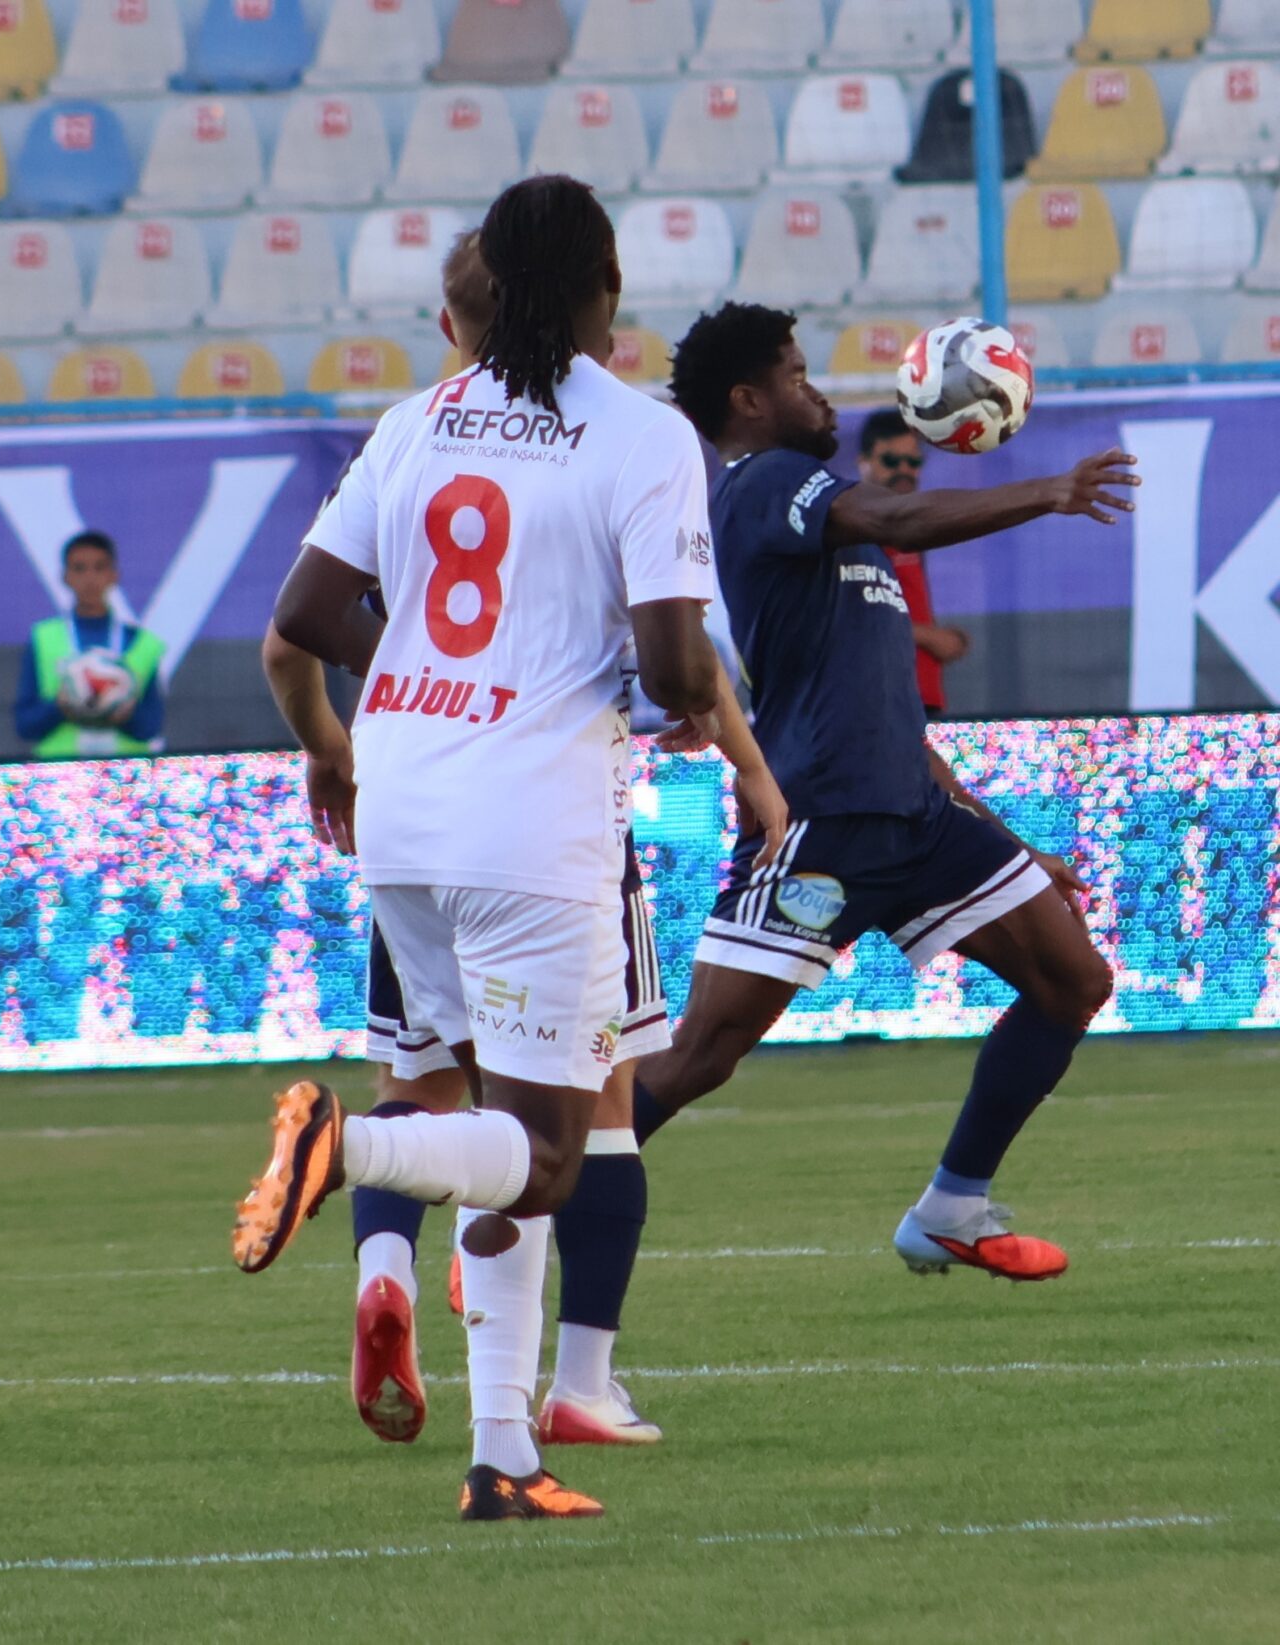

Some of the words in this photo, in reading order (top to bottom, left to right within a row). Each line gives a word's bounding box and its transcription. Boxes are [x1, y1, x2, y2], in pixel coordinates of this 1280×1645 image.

[433, 406, 588, 450] REFORM
[424, 473, 511, 659] 8
[839, 563, 878, 582] NEW
[364, 665, 518, 726] ALİOU.T
